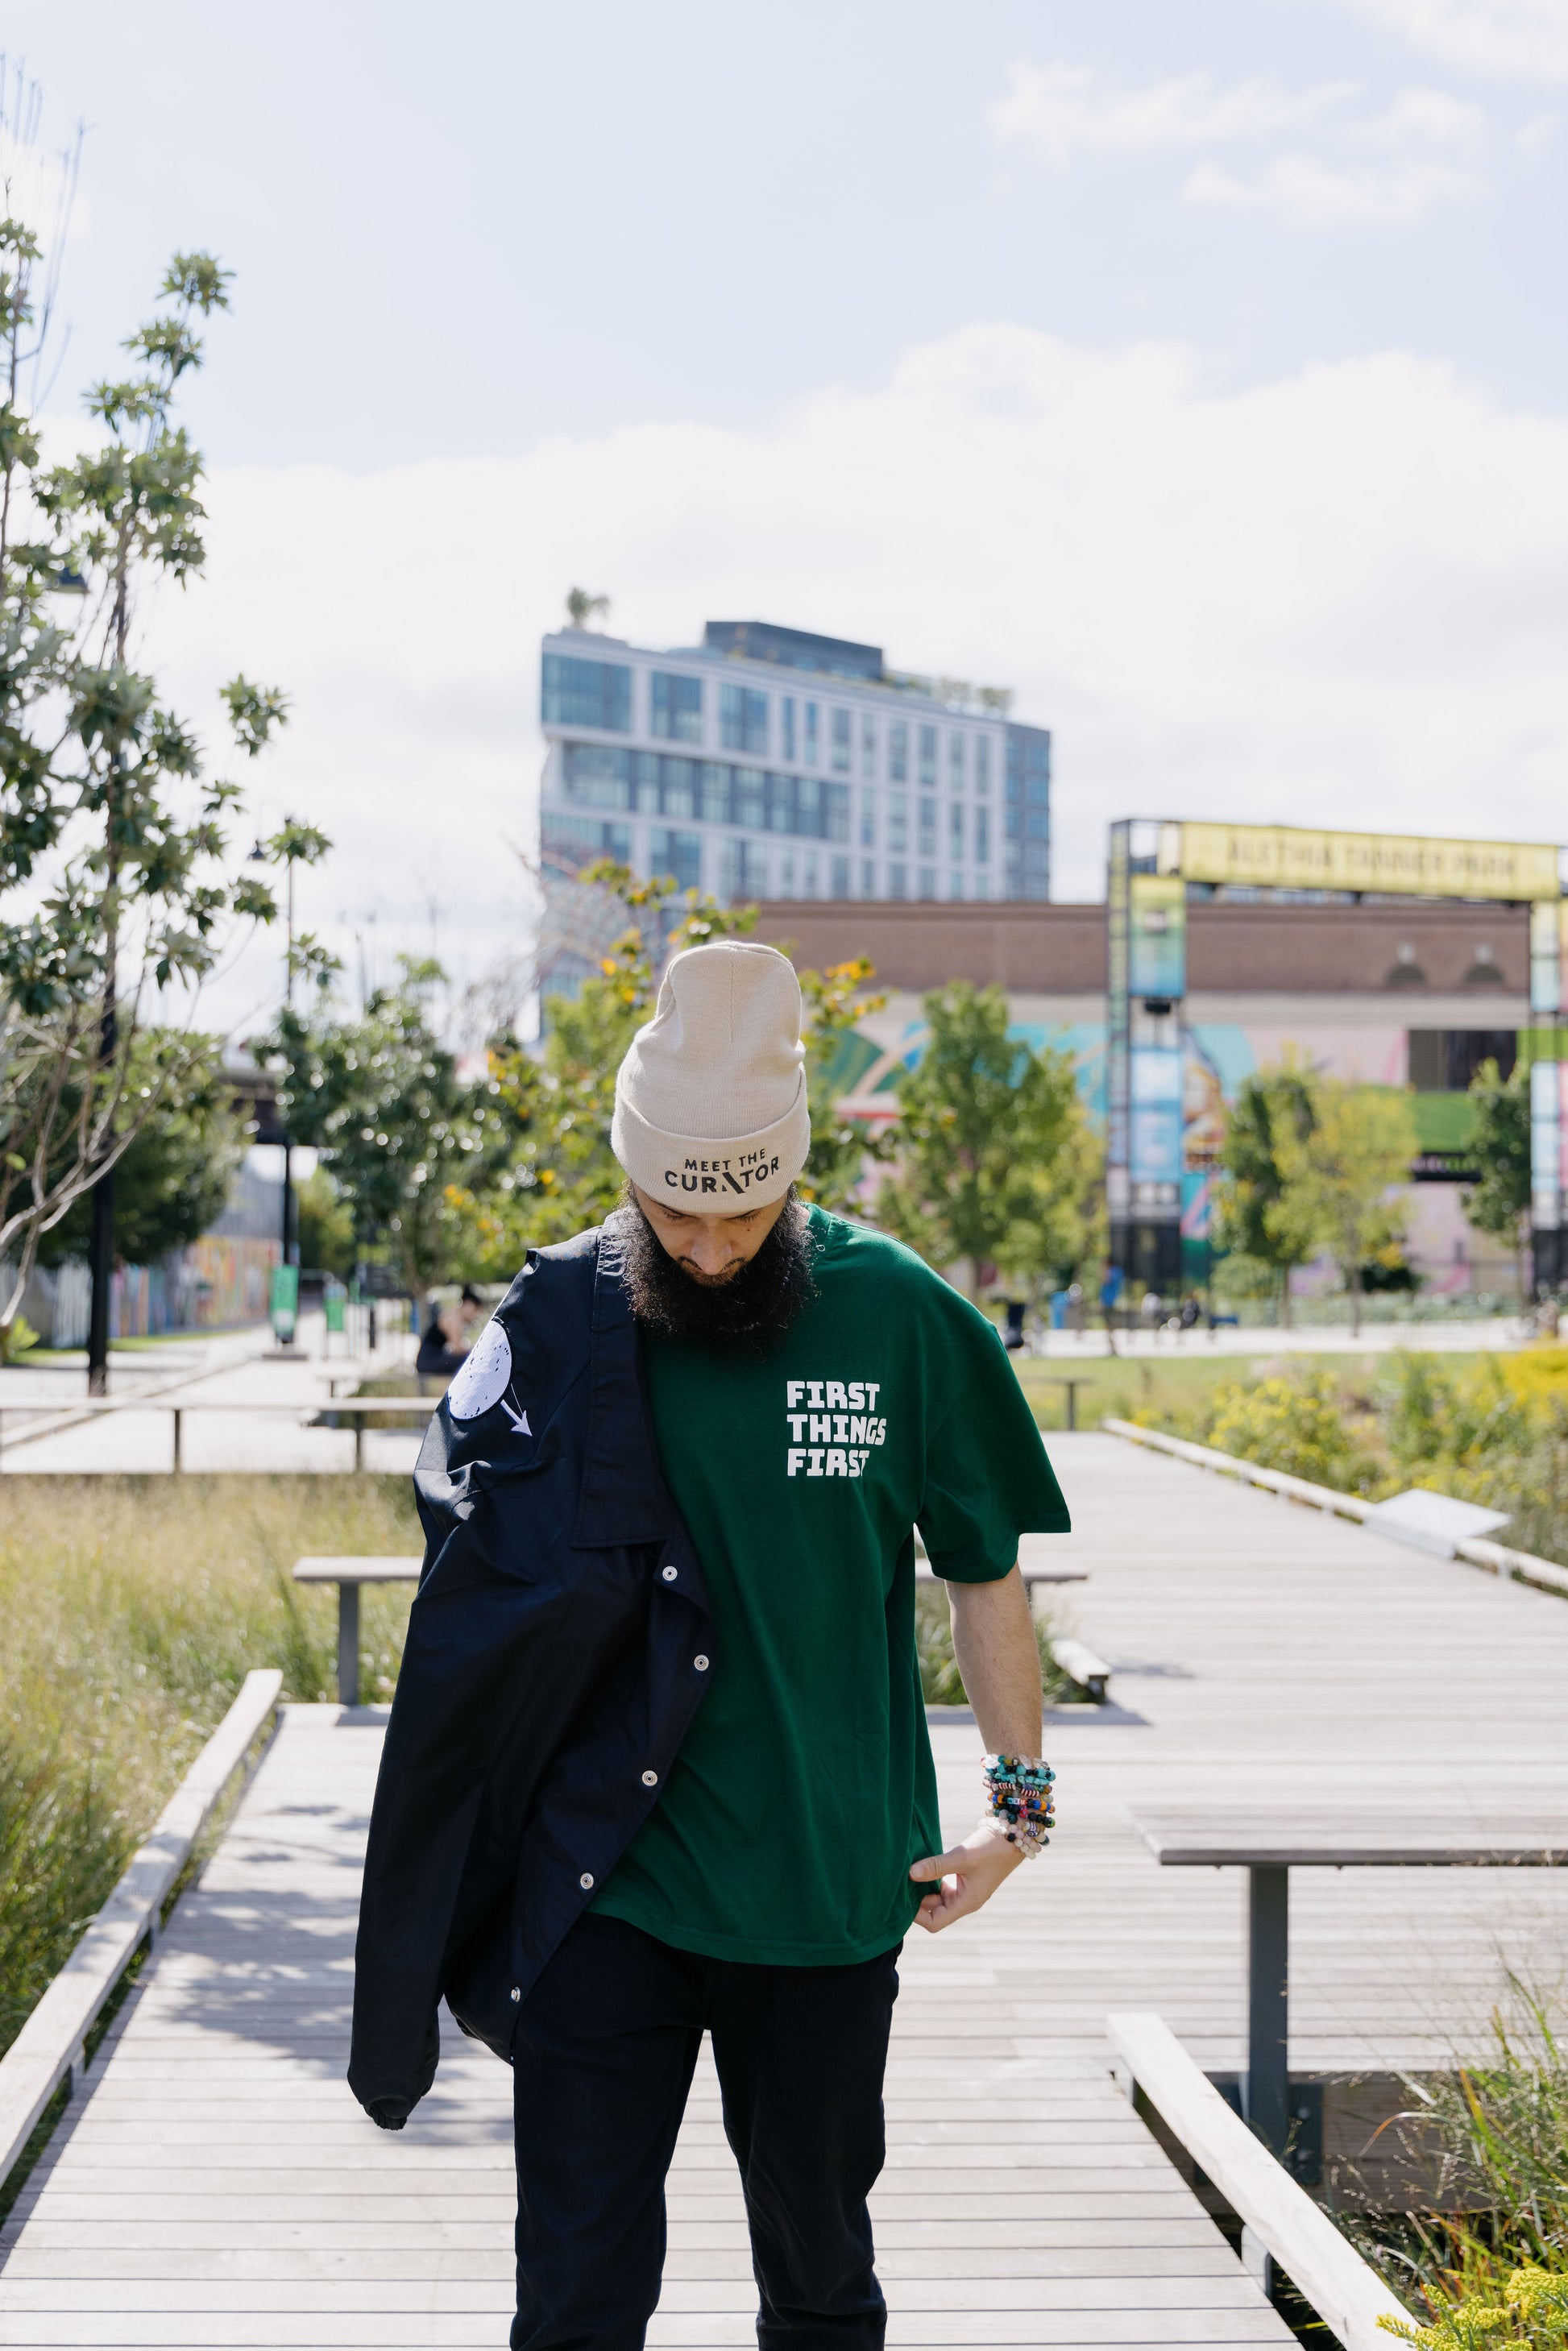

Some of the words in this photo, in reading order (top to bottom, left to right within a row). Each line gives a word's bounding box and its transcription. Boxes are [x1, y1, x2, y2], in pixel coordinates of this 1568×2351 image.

[664, 1155, 779, 1194] CURATOR
[684, 1159, 731, 1172] MEET
[738, 1148, 765, 1167] THE
[786, 1380, 880, 1412] FIRST
[786, 1414, 887, 1445] THINGS
[787, 1448, 869, 1477] FIRST
